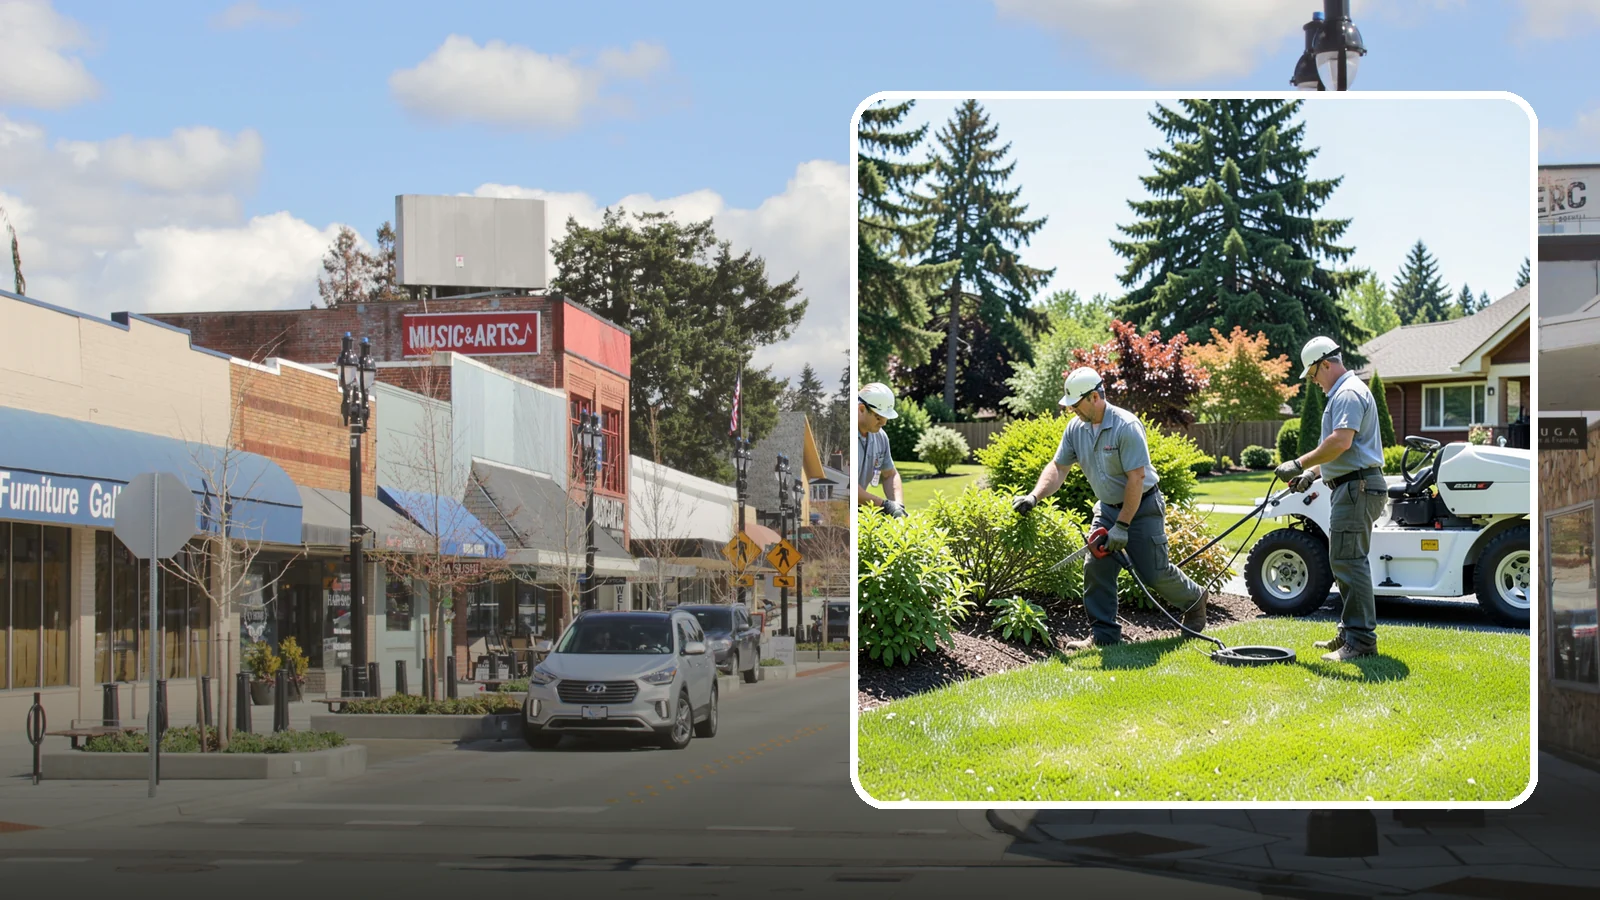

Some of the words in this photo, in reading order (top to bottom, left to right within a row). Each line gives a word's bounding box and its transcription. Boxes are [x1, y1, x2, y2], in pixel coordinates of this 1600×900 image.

[409, 323, 519, 348] MUSIC&ARTS
[1540, 427, 1577, 436] UGA
[0, 471, 79, 515] Furniture
